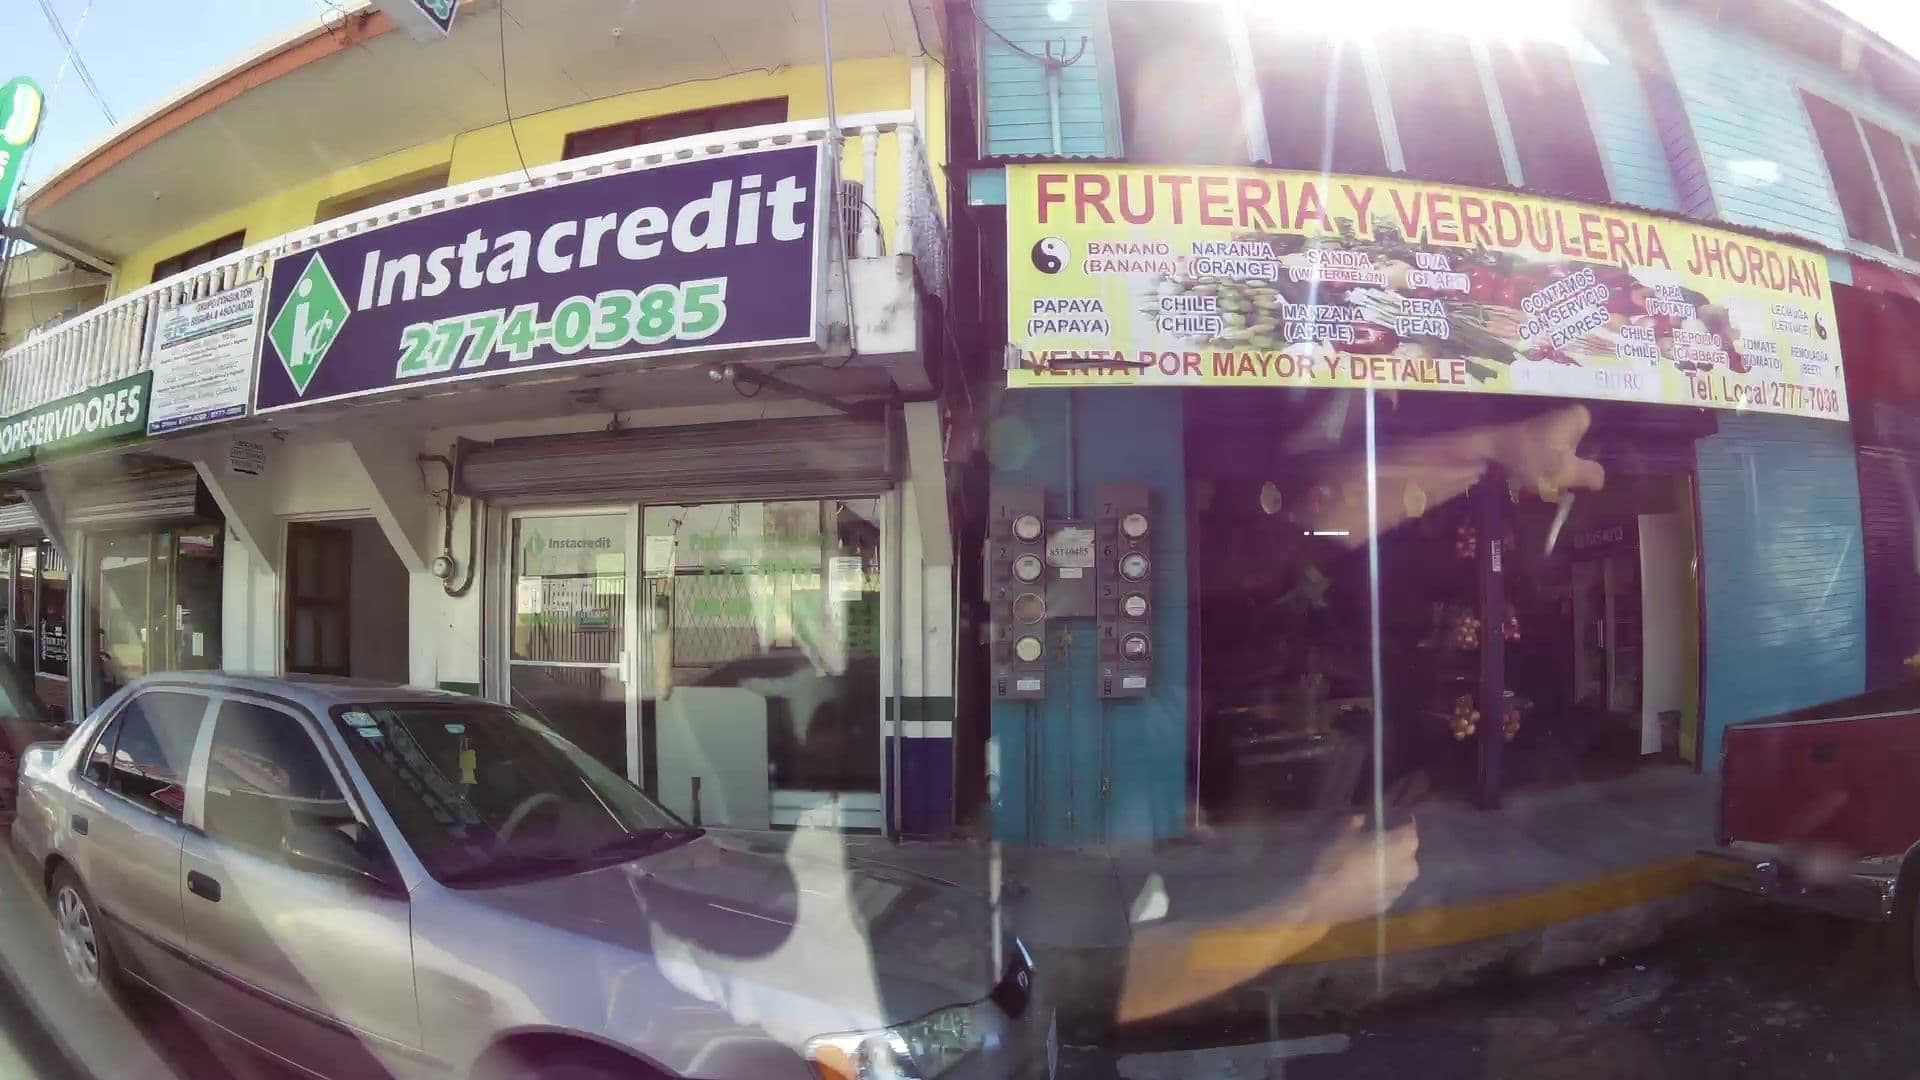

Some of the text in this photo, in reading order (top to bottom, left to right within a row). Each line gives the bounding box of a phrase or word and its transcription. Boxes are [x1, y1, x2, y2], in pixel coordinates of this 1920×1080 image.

[357, 174, 807, 312] Instacredit
[1036, 174, 1821, 300] FRUTERIA Y VERDULERIA JHORDAN
[1087, 242, 1169, 256] BANANO
[1192, 242, 1275, 259] NARANJA
[1083, 259, 1177, 275] (BANANA)
[1307, 251, 1371, 269] SANDIA
[1521, 268, 1596, 315] CONTAMOS
[1033, 300, 1104, 313] PAPAYA
[1161, 298, 1216, 313] CHILE
[1401, 300, 1446, 315] PERA
[1549, 283, 1608, 324] SERVICIO
[396, 276, 728, 379] 2774-0385
[1027, 318, 1110, 336] (PAPAYA)
[1156, 314, 1222, 335] (CHILE)
[1395, 319, 1449, 339] (PEAR)
[1550, 308, 1610, 349] EXPRESS
[1620, 327, 1655, 342] CHILE
[1028, 351, 1466, 386] VENTA POR MAYOR Y DETALLE
[1686, 374, 1718, 402] Tel.
[0, 385, 142, 455] OPESERVIDORES
[548, 536, 612, 550] Instacredit
